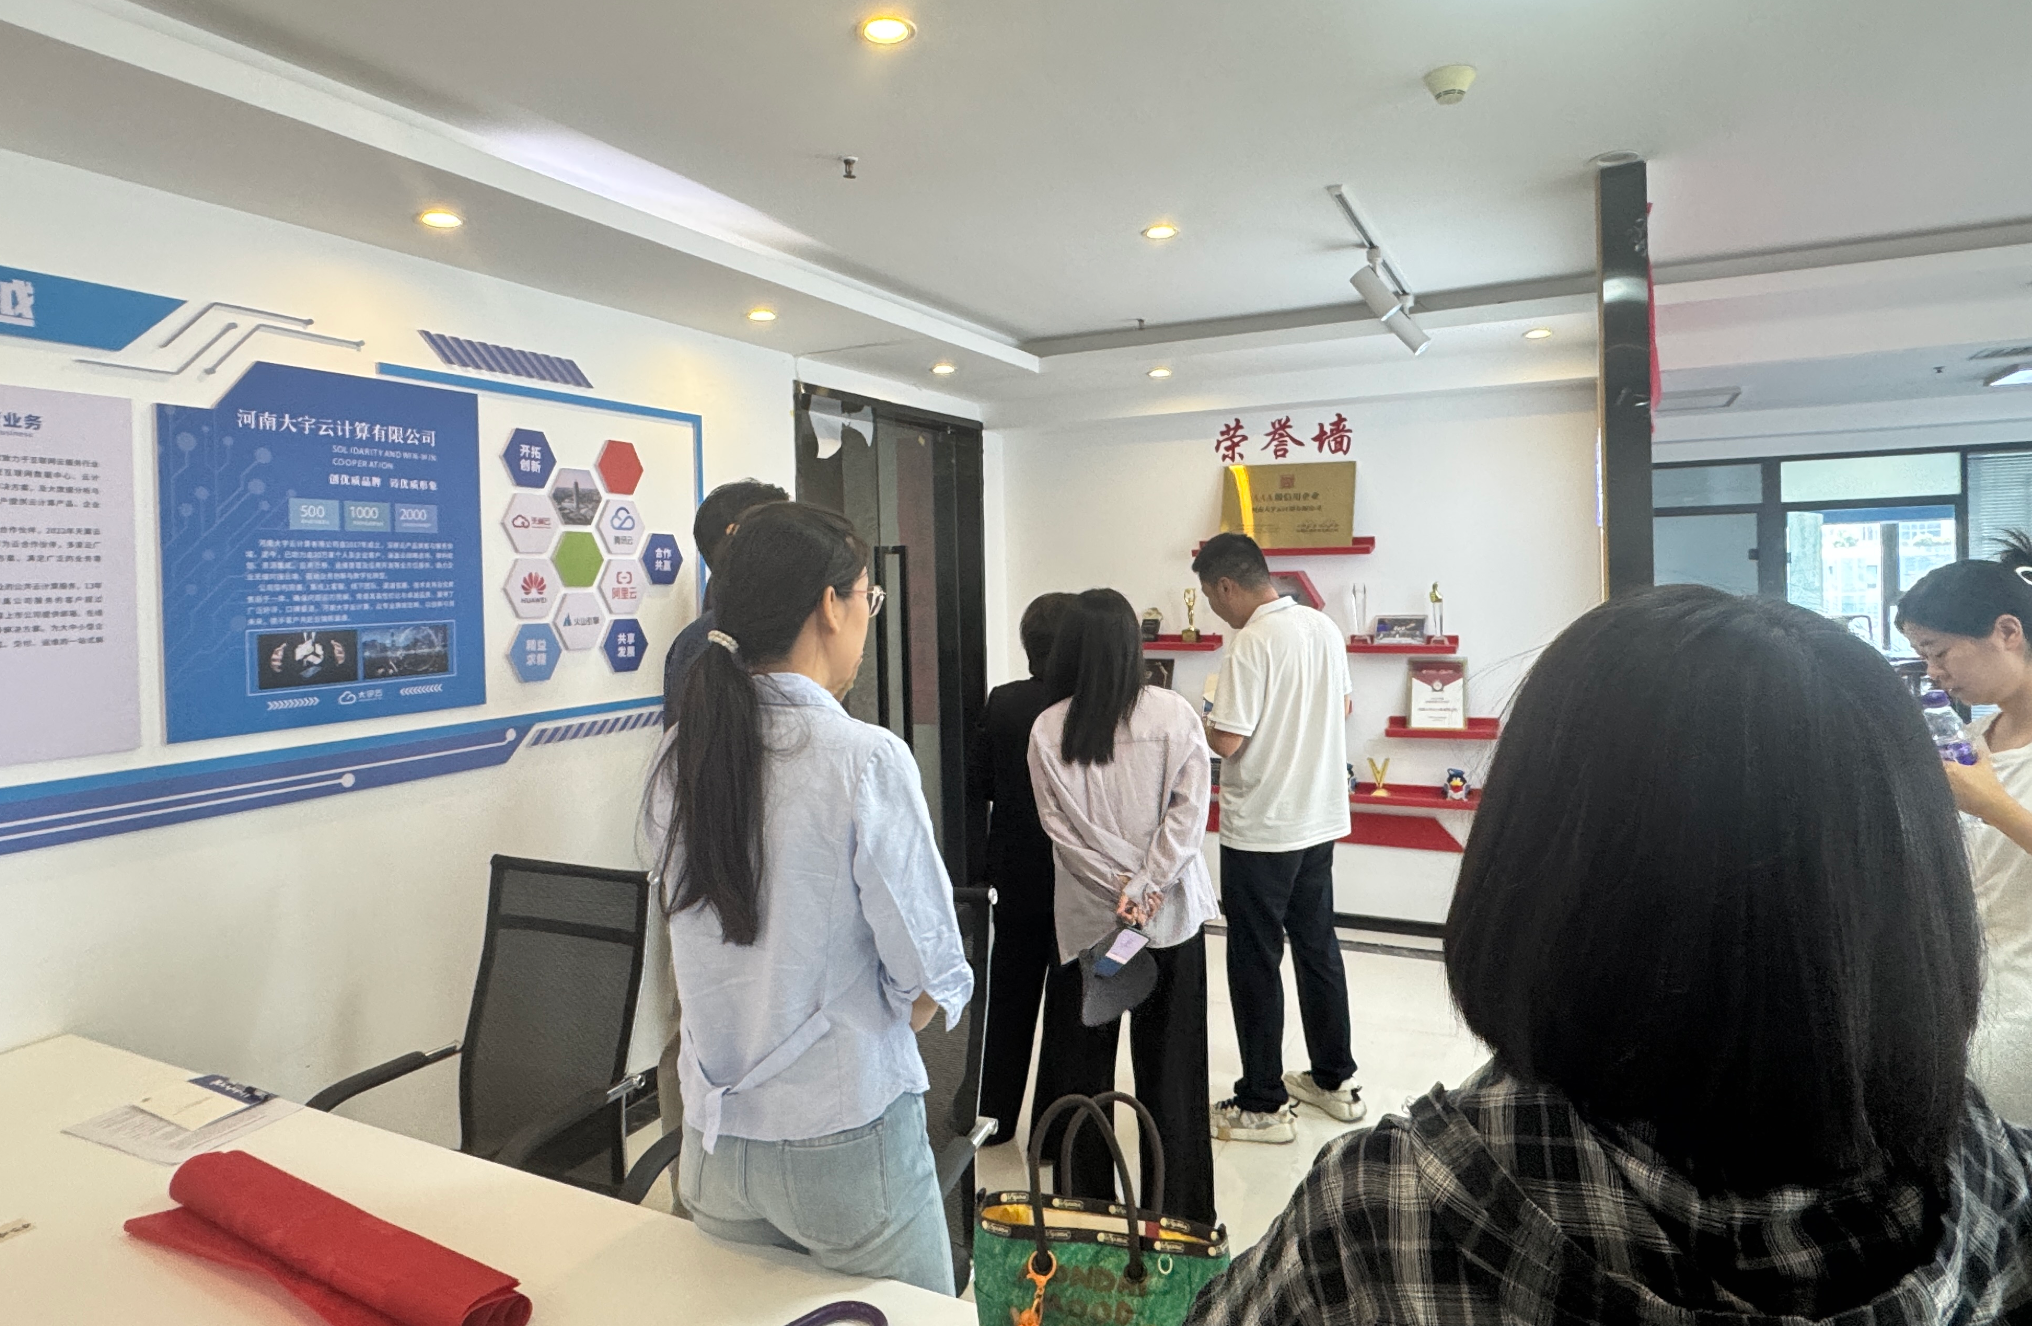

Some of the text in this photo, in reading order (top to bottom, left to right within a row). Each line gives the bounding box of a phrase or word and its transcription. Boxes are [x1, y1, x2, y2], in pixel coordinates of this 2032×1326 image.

[3, 412, 42, 430] 业务
[237, 409, 437, 447] 河南大宇云计算有限公司
[1215, 413, 1353, 462] 荣誉墙
[519, 444, 542, 459] 开拓
[519, 459, 542, 473] 创新
[300, 505, 325, 518] 500
[349, 507, 379, 520] 1000
[399, 509, 427, 522] 2000
[655, 547, 672, 559] 合作
[617, 633, 636, 645] 共享
